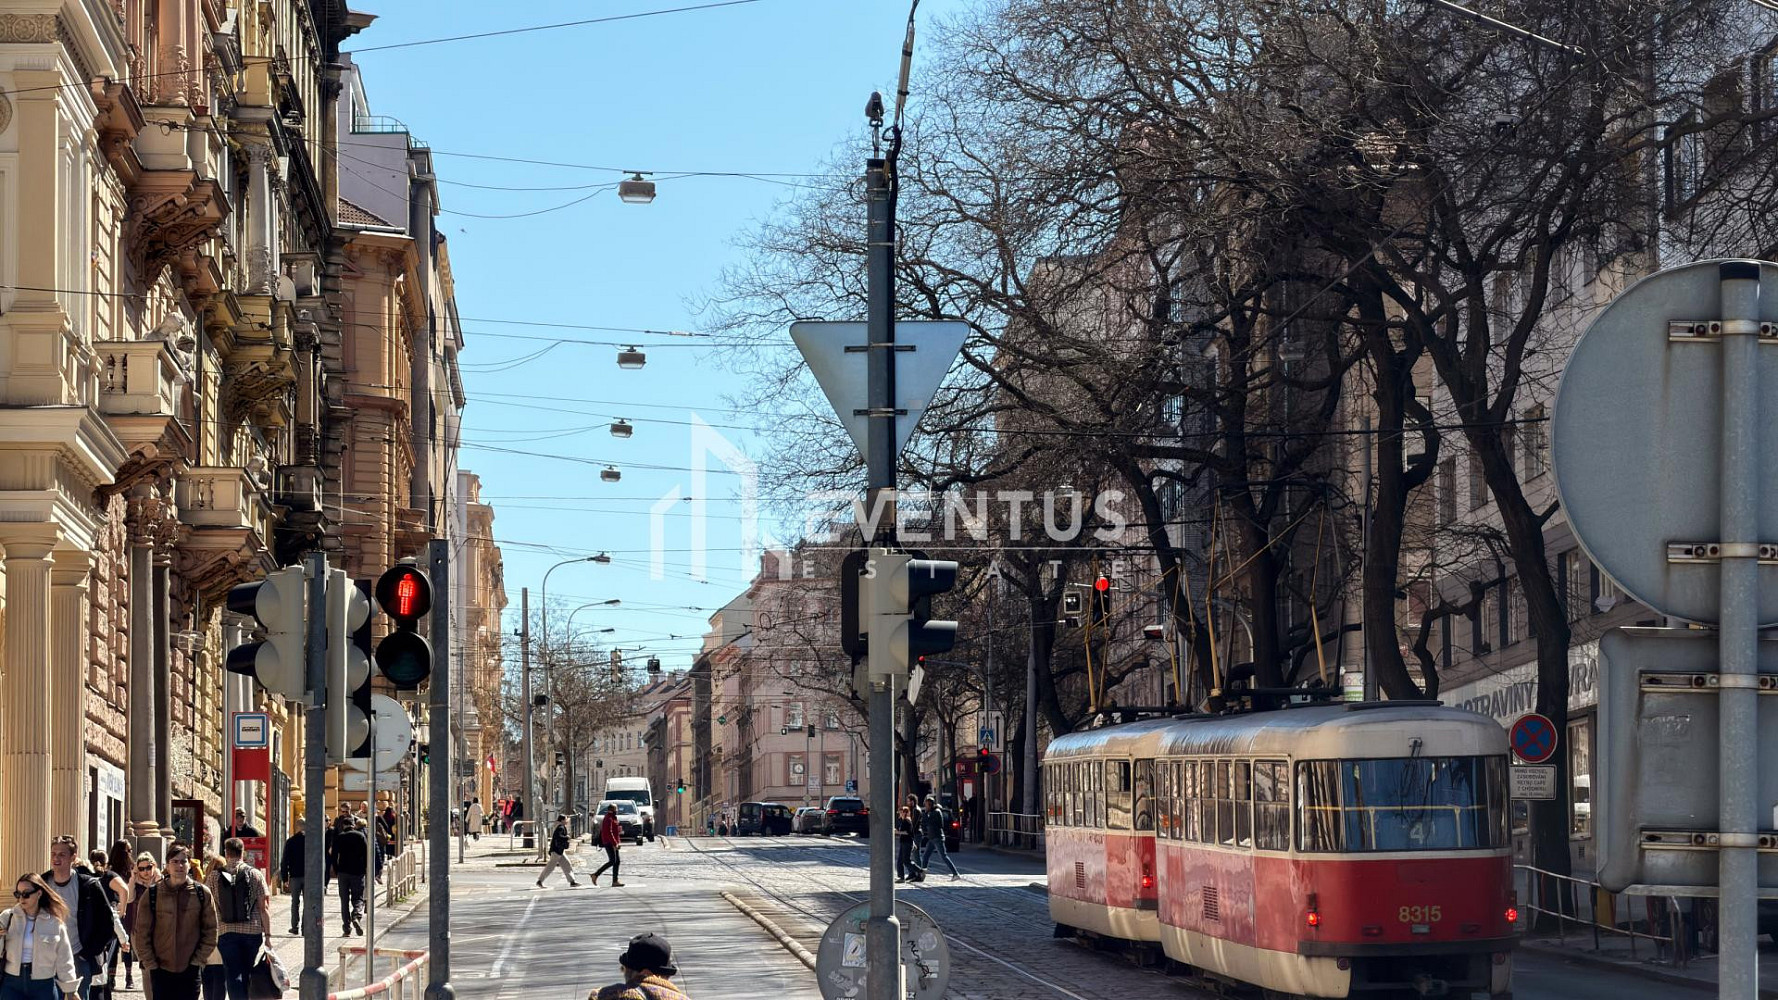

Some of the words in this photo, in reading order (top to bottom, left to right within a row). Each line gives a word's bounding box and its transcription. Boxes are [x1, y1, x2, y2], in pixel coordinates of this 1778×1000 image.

[1455, 682, 1534, 718] TRAVINY
[1410, 821, 1425, 845] 4
[1398, 905, 1442, 923] 8315
